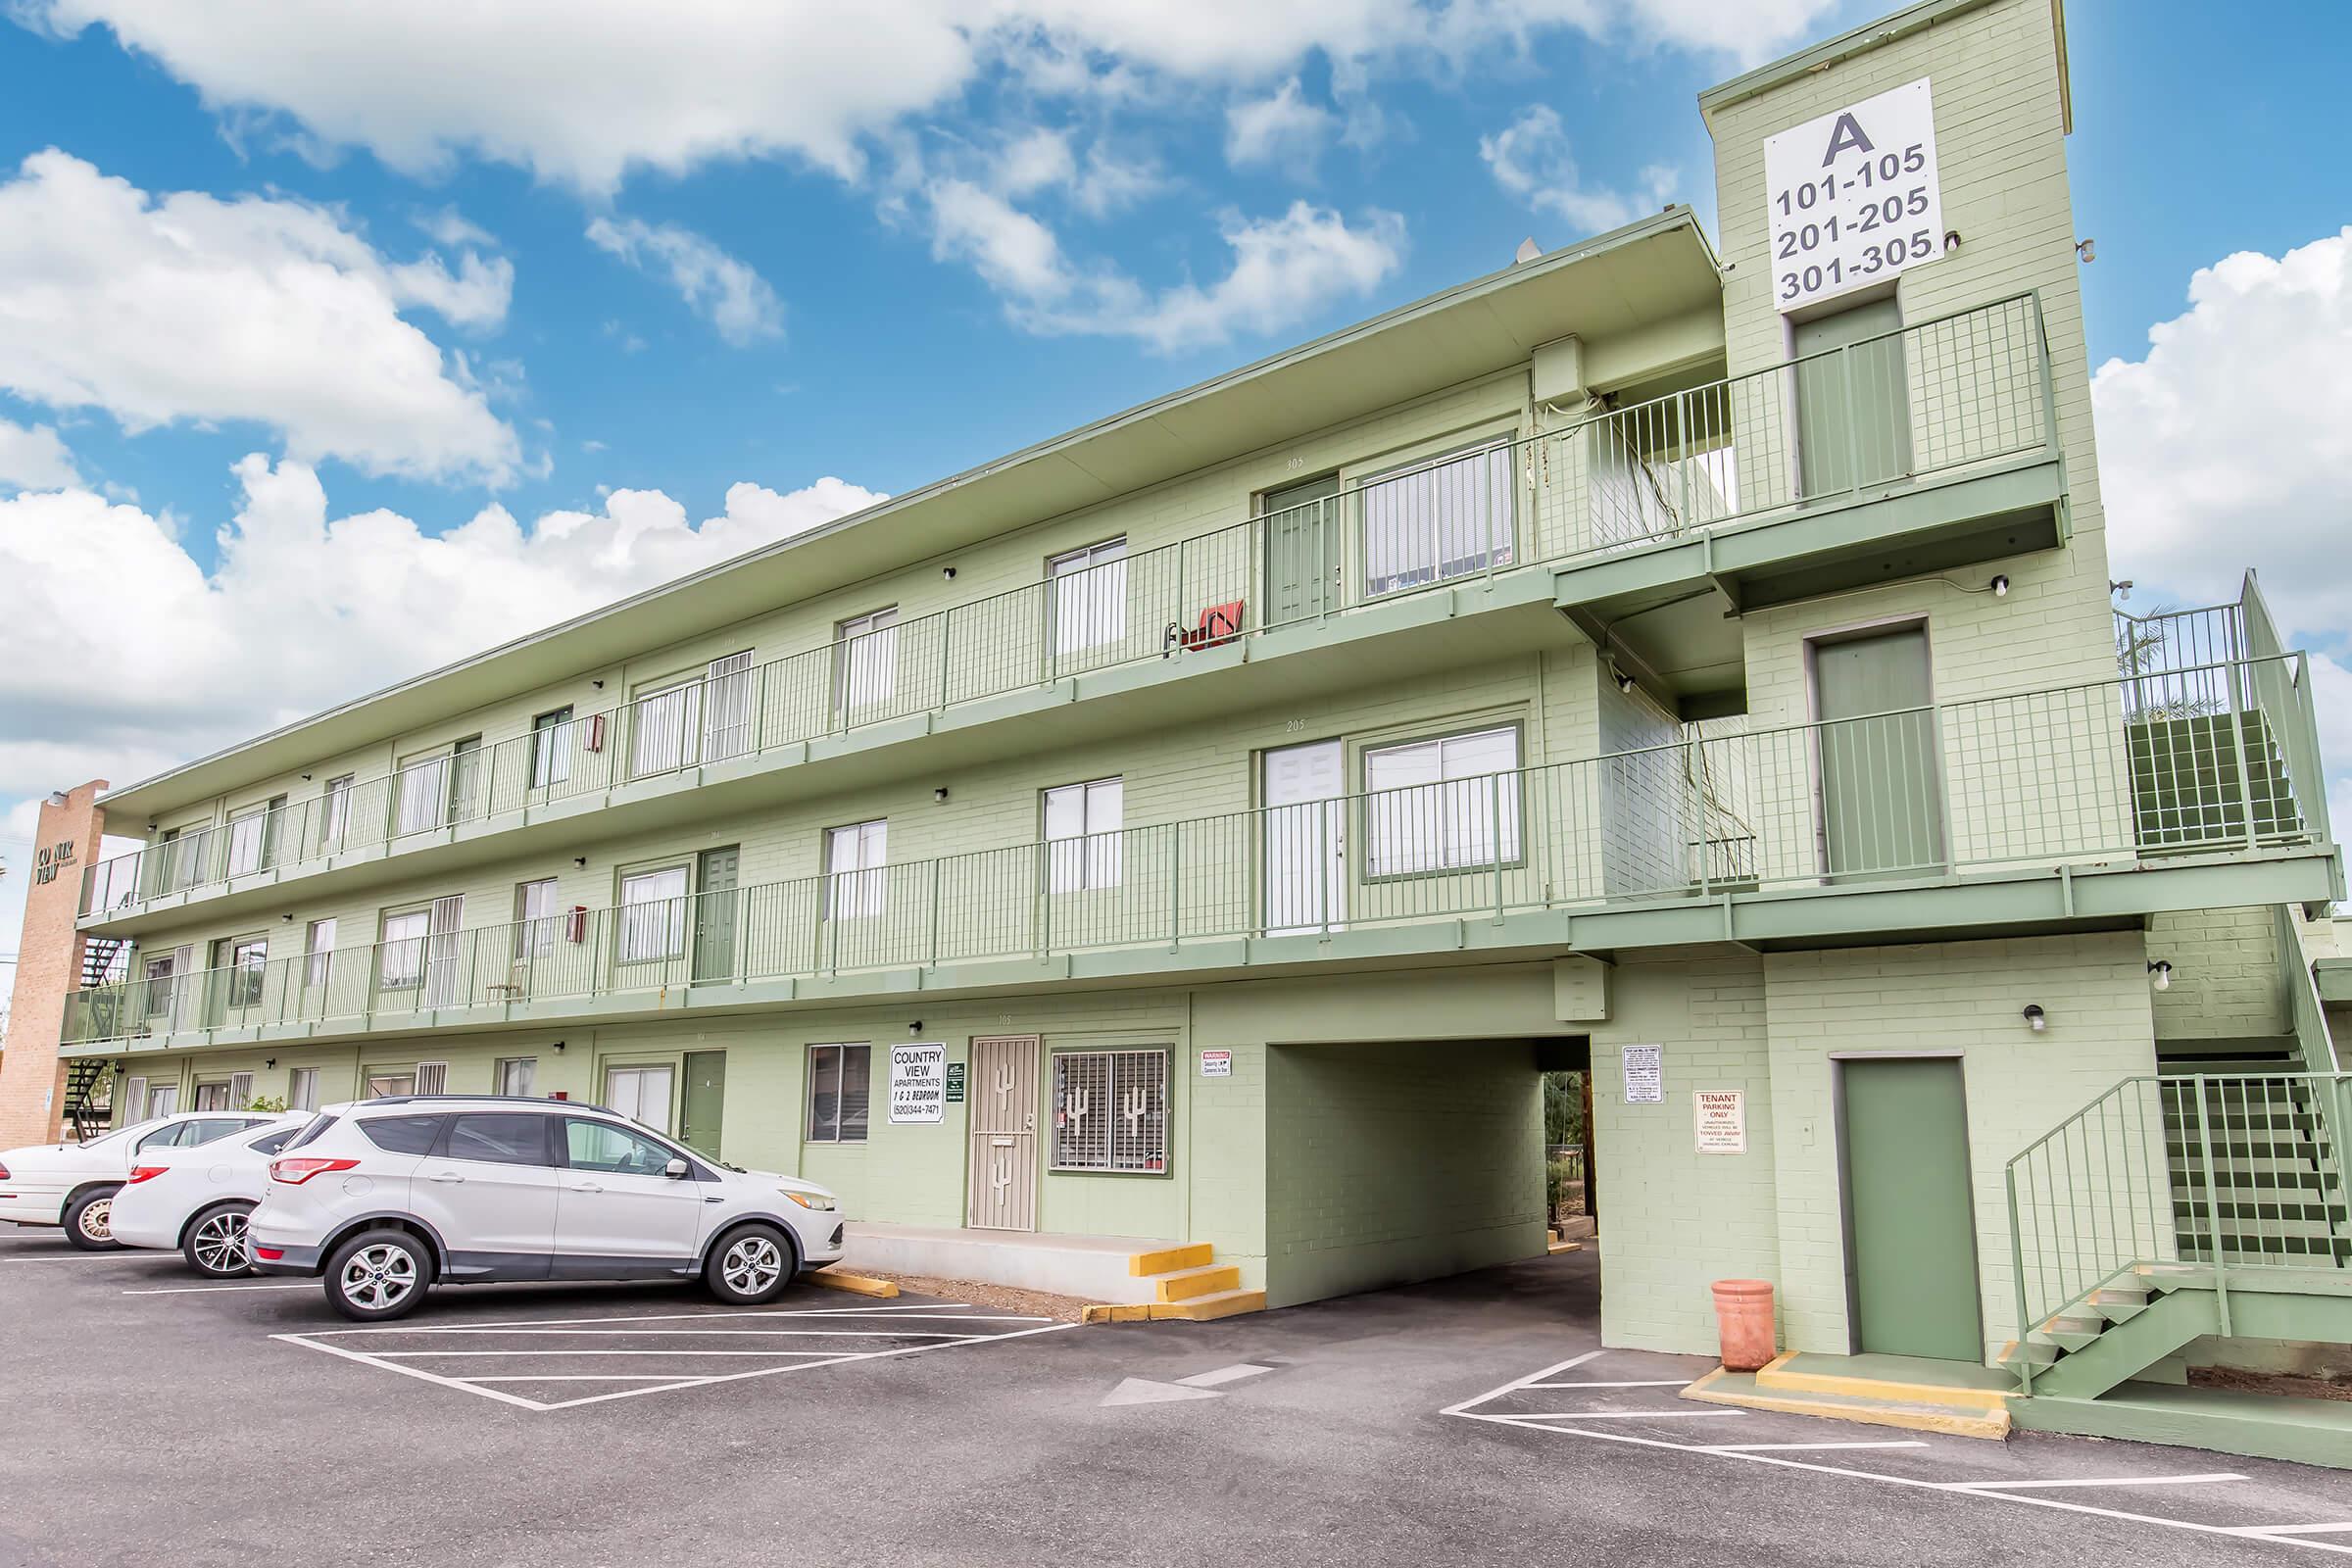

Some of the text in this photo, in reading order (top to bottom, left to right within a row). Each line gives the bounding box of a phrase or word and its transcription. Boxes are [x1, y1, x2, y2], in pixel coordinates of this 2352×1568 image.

[1822, 112, 1875, 168] A
[1777, 143, 1925, 216] 101-105
[1778, 186, 1929, 260] 201-205
[1781, 228, 1932, 299] 301-305
[1287, 458, 1303, 471] 305
[1286, 719, 1305, 733] 205
[36, 862, 60, 885] VIEW
[999, 1014, 1011, 1026] 105
[894, 1051, 942, 1064] COUNTRY
[905, 1065, 930, 1077] VIEW
[894, 1078, 941, 1087] APARTMENTS
[894, 1091, 898, 1101] 1
[906, 1090, 910, 1101] 2
[911, 1090, 939, 1101] BEDROOM
